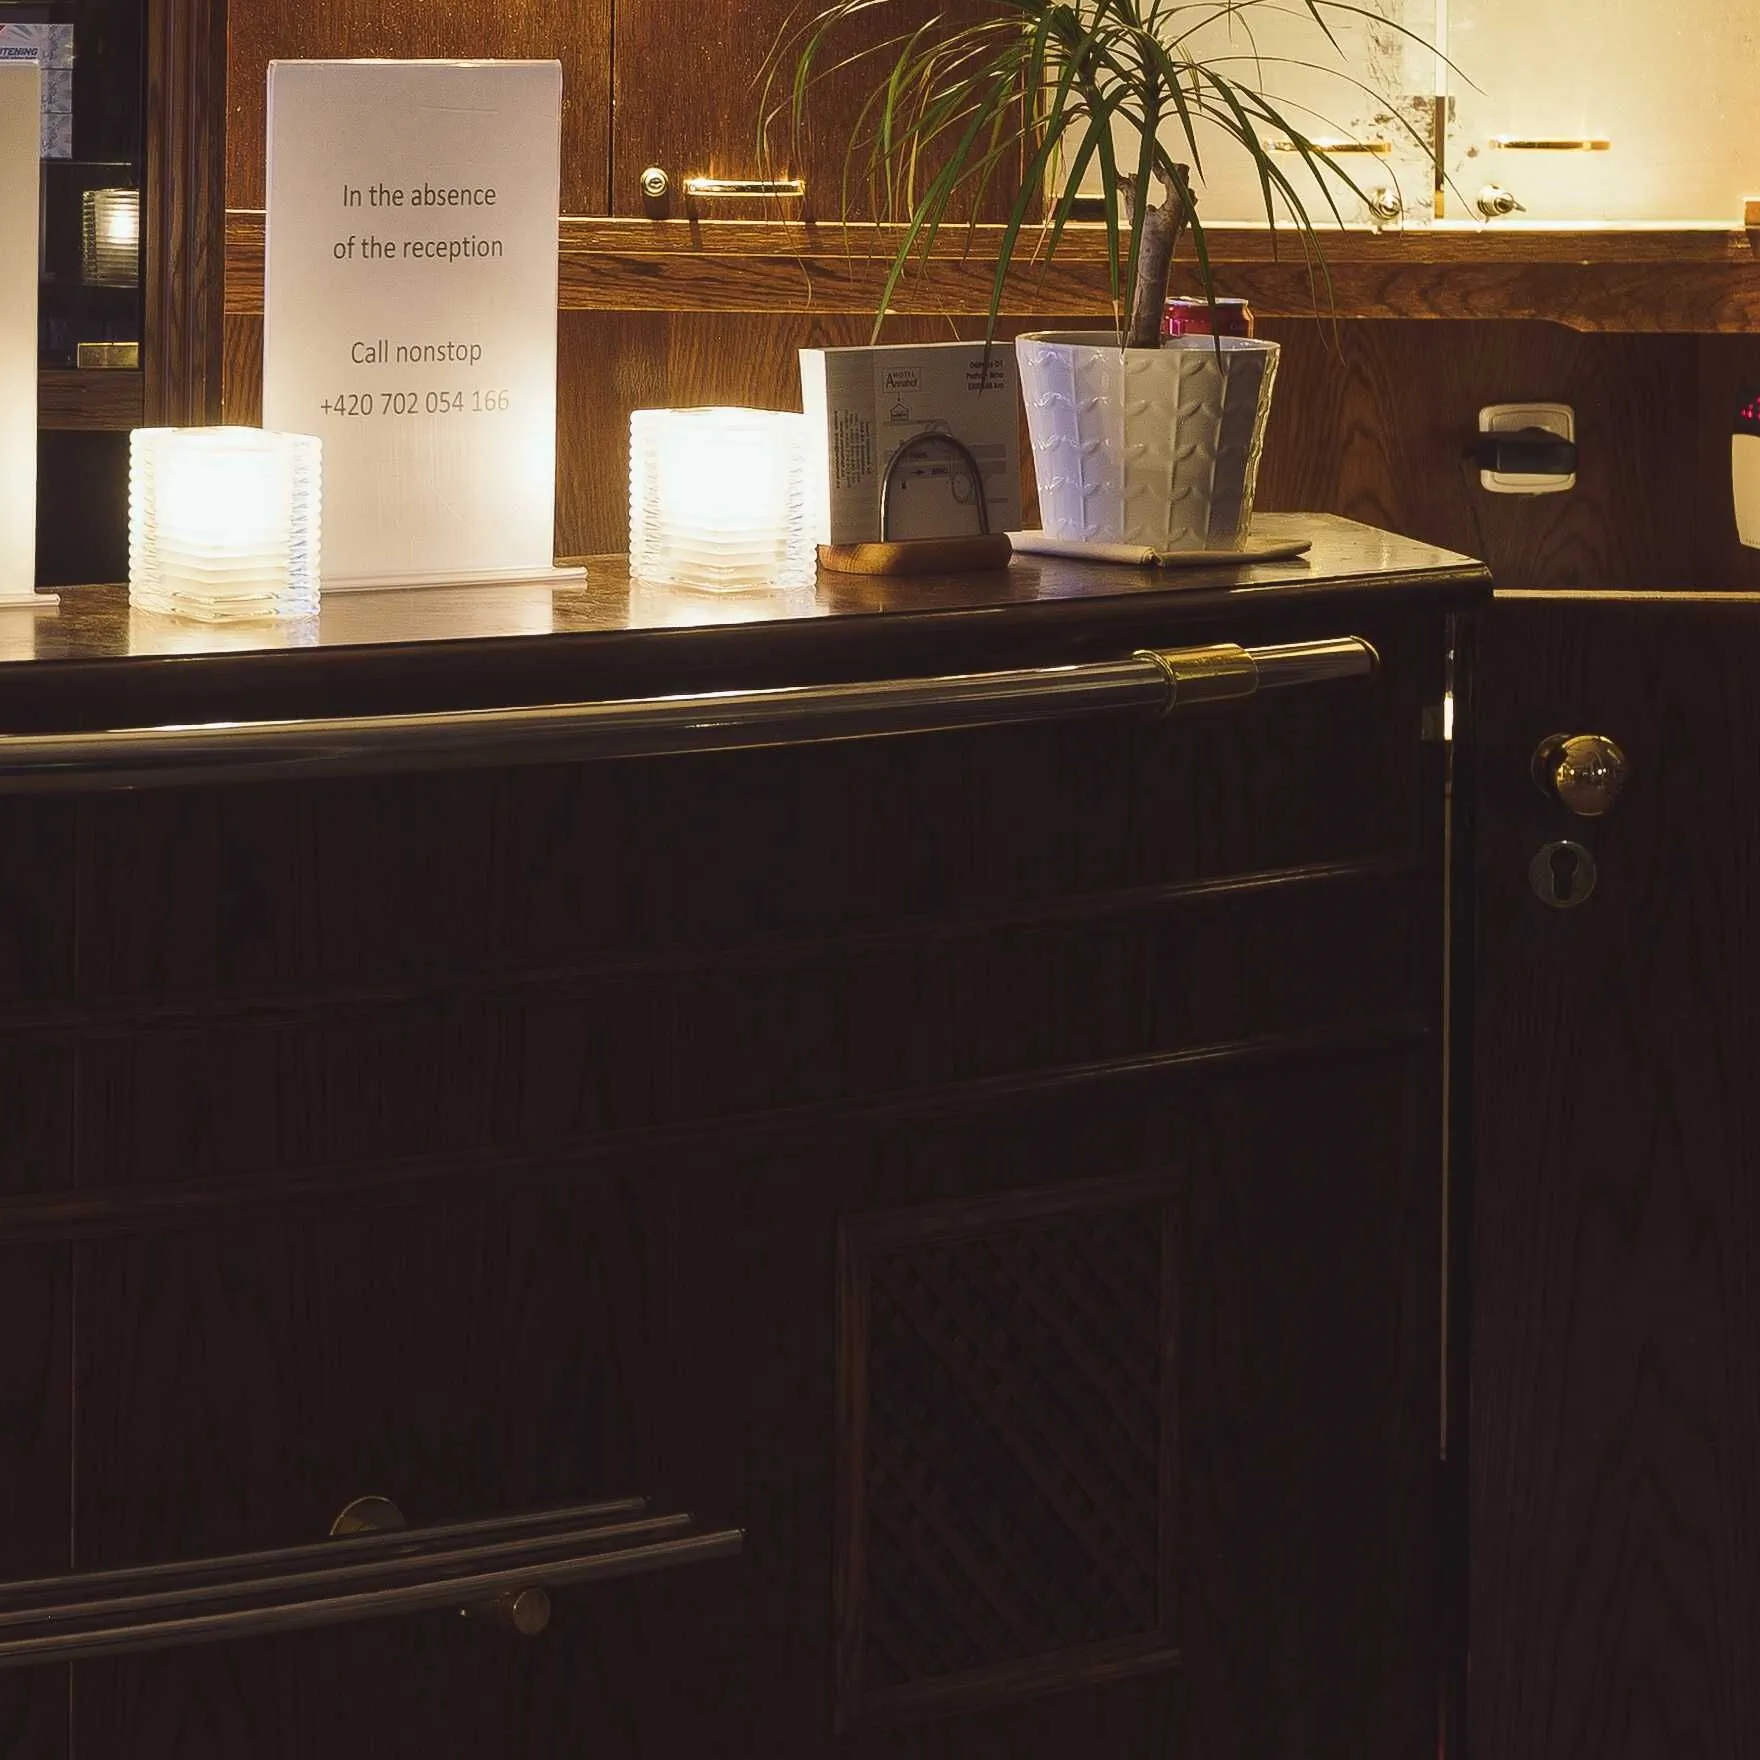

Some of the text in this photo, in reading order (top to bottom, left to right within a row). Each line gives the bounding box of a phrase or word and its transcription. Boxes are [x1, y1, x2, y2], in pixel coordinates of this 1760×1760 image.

[343, 183, 496, 207] In the absence
[333, 234, 503, 263] of the reception
[351, 339, 482, 365] Call nonstop
[320, 389, 510, 417] +420 702 054 166
